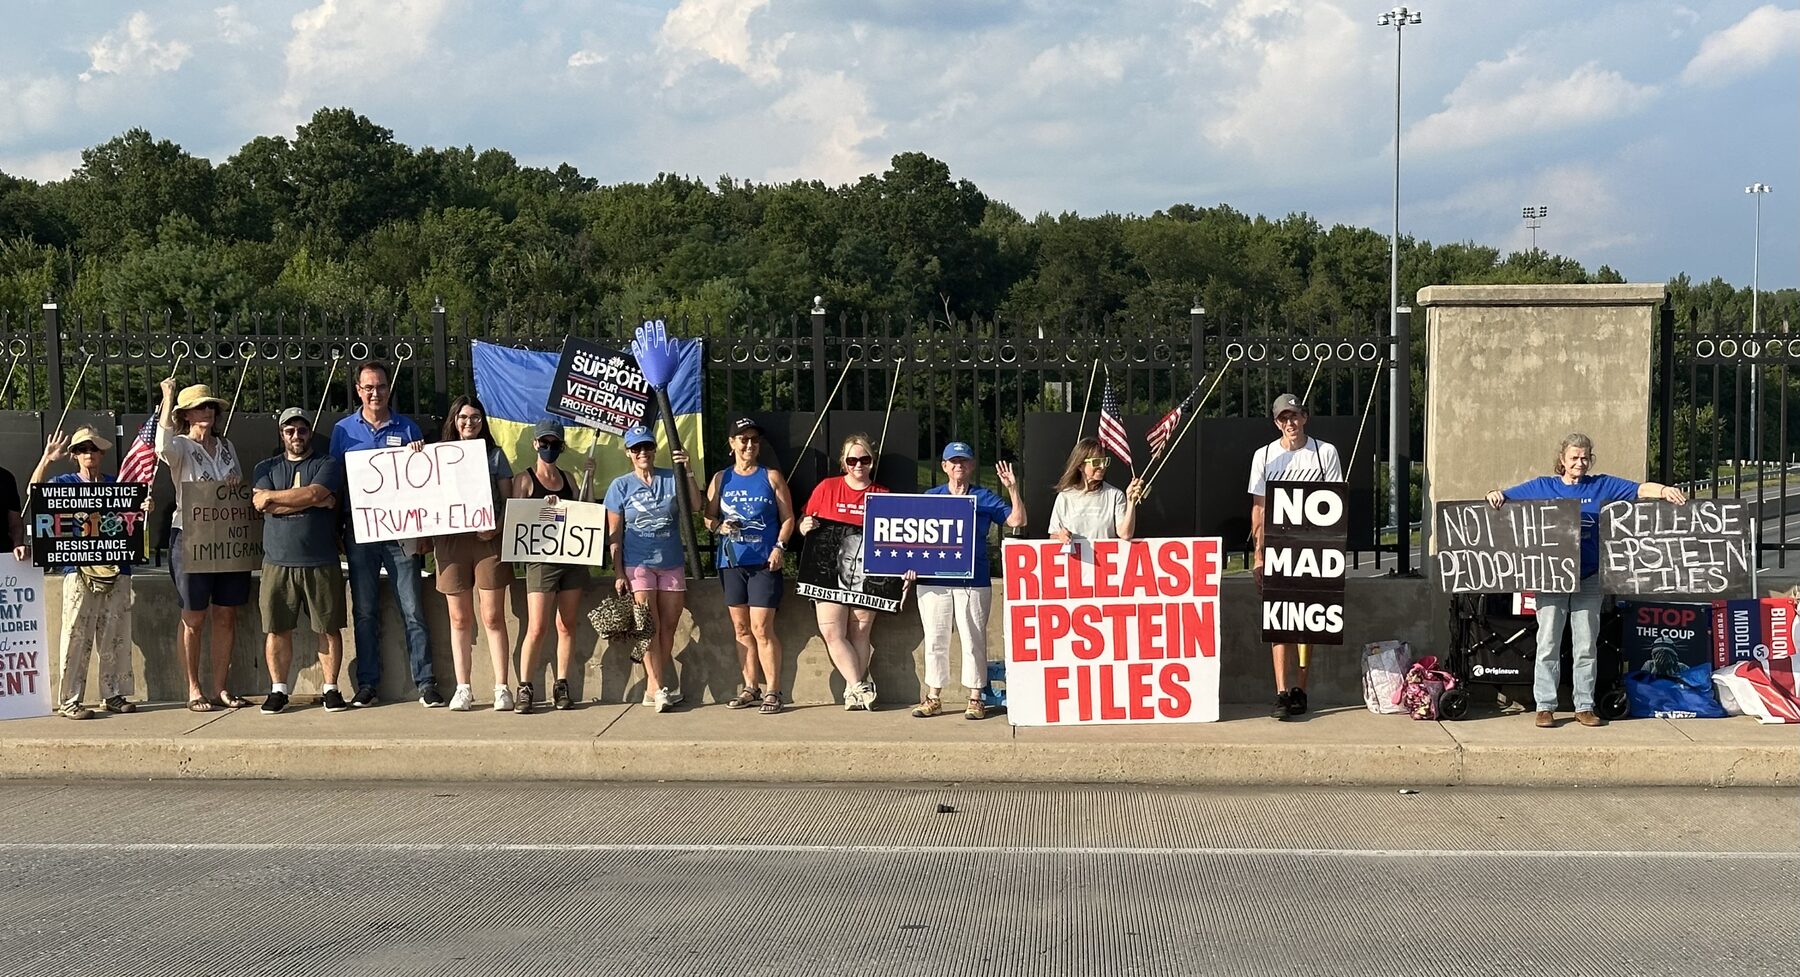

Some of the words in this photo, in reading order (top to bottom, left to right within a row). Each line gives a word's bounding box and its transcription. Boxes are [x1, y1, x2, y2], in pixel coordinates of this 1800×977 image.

[571, 355, 649, 393] SUPPORT
[599, 381, 618, 393] OUR
[561, 397, 604, 416] PROTECT
[607, 411, 625, 424] THE
[567, 380, 645, 417] VETERANS
[362, 444, 465, 494] STOP
[42, 487, 75, 497] WHEN
[80, 486, 138, 496] INJUSTICE
[48, 498, 102, 508] BECOMES
[106, 498, 132, 508] LAW
[216, 484, 249, 500] CAG
[355, 507, 428, 538] TRUMP
[433, 512, 441, 524] +
[449, 504, 492, 528] ELON
[1272, 488, 1343, 527] NO
[1600, 500, 1742, 538] RELEASE
[228, 525, 249, 539] NOT
[513, 507, 601, 558] RESIST
[874, 517, 963, 544] RESIST!
[1443, 506, 1494, 547] NOT
[1509, 504, 1559, 548] THE
[47, 552, 102, 562] BECOMES
[106, 551, 135, 560] DUTY
[56, 540, 127, 550] RESISTANCE
[193, 542, 265, 560] IMMIGRAN
[1605, 537, 1748, 572] EPSTEIN
[1005, 540, 1218, 600] RELEASE
[1264, 547, 1345, 578] MAD
[1438, 550, 1576, 593] PEDOPHILES
[1626, 565, 1728, 594] FILES
[14, 588, 35, 602] TO
[804, 585, 839, 600] RESIST
[843, 592, 895, 609] TYRANNY
[0, 604, 23, 620] MY
[0, 620, 38, 634] LDREN
[1263, 601, 1343, 633] KINGS
[1637, 607, 1696, 626] STOP
[1010, 601, 1216, 662] EPSTEIN
[1636, 627, 1658, 637] THE
[1660, 628, 1695, 639] COUP
[1734, 610, 1750, 657] MIDDLE
[1771, 608, 1788, 659] BILLION
[1044, 662, 1191, 723] FILES
